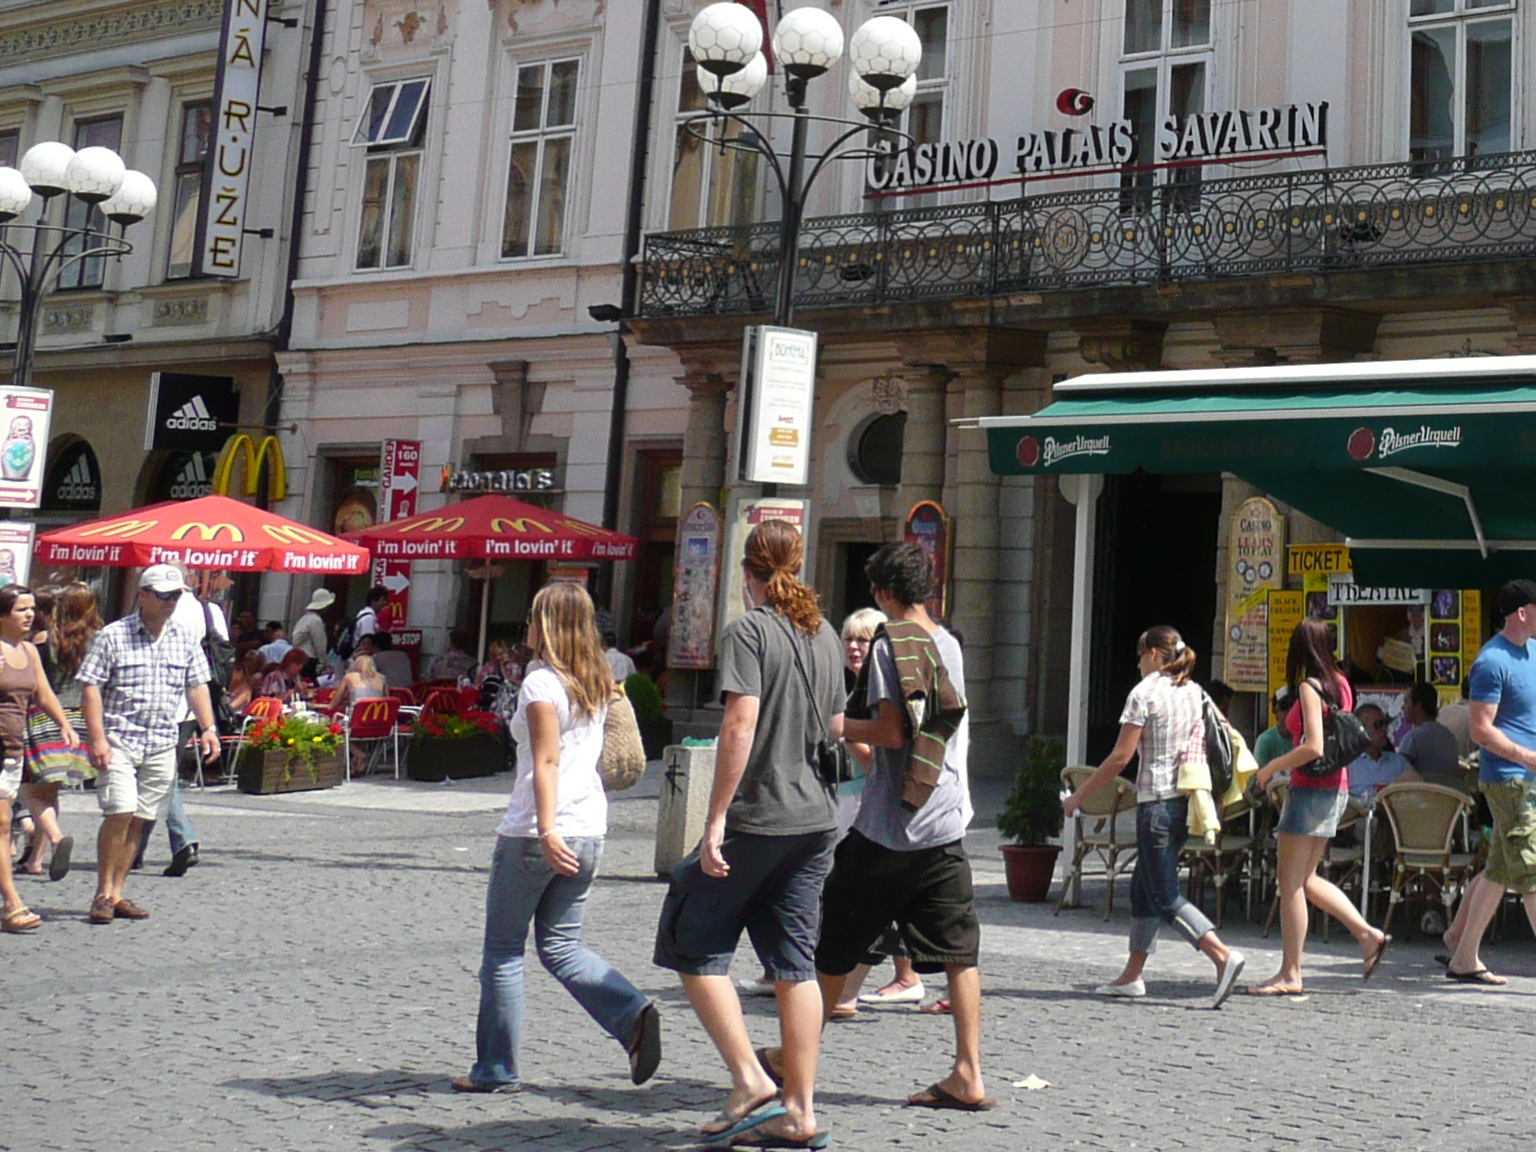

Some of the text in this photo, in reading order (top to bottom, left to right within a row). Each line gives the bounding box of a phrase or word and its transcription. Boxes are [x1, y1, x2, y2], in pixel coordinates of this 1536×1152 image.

[867, 101, 1329, 189] CASINO PALAIS SAVARIN
[209, 99, 251, 269] RŮŽE
[166, 416, 217, 431] adidas
[1043, 434, 1110, 467] Pilsner Urquell
[1379, 425, 1460, 459] Pilsner Urquell
[57, 486, 96, 499] adidas
[170, 482, 212, 498] adidas
[50, 544, 70, 559] i'm
[72, 544, 109, 561] lovin'
[111, 545, 121, 561] it
[377, 539, 456, 554] i'm lovin' it
[486, 538, 573, 554] i'm lovin' it
[151, 546, 255, 566] i'm lovin' it
[284, 552, 358, 569] i'm lovin' it
[1291, 550, 1342, 571] TICKET
